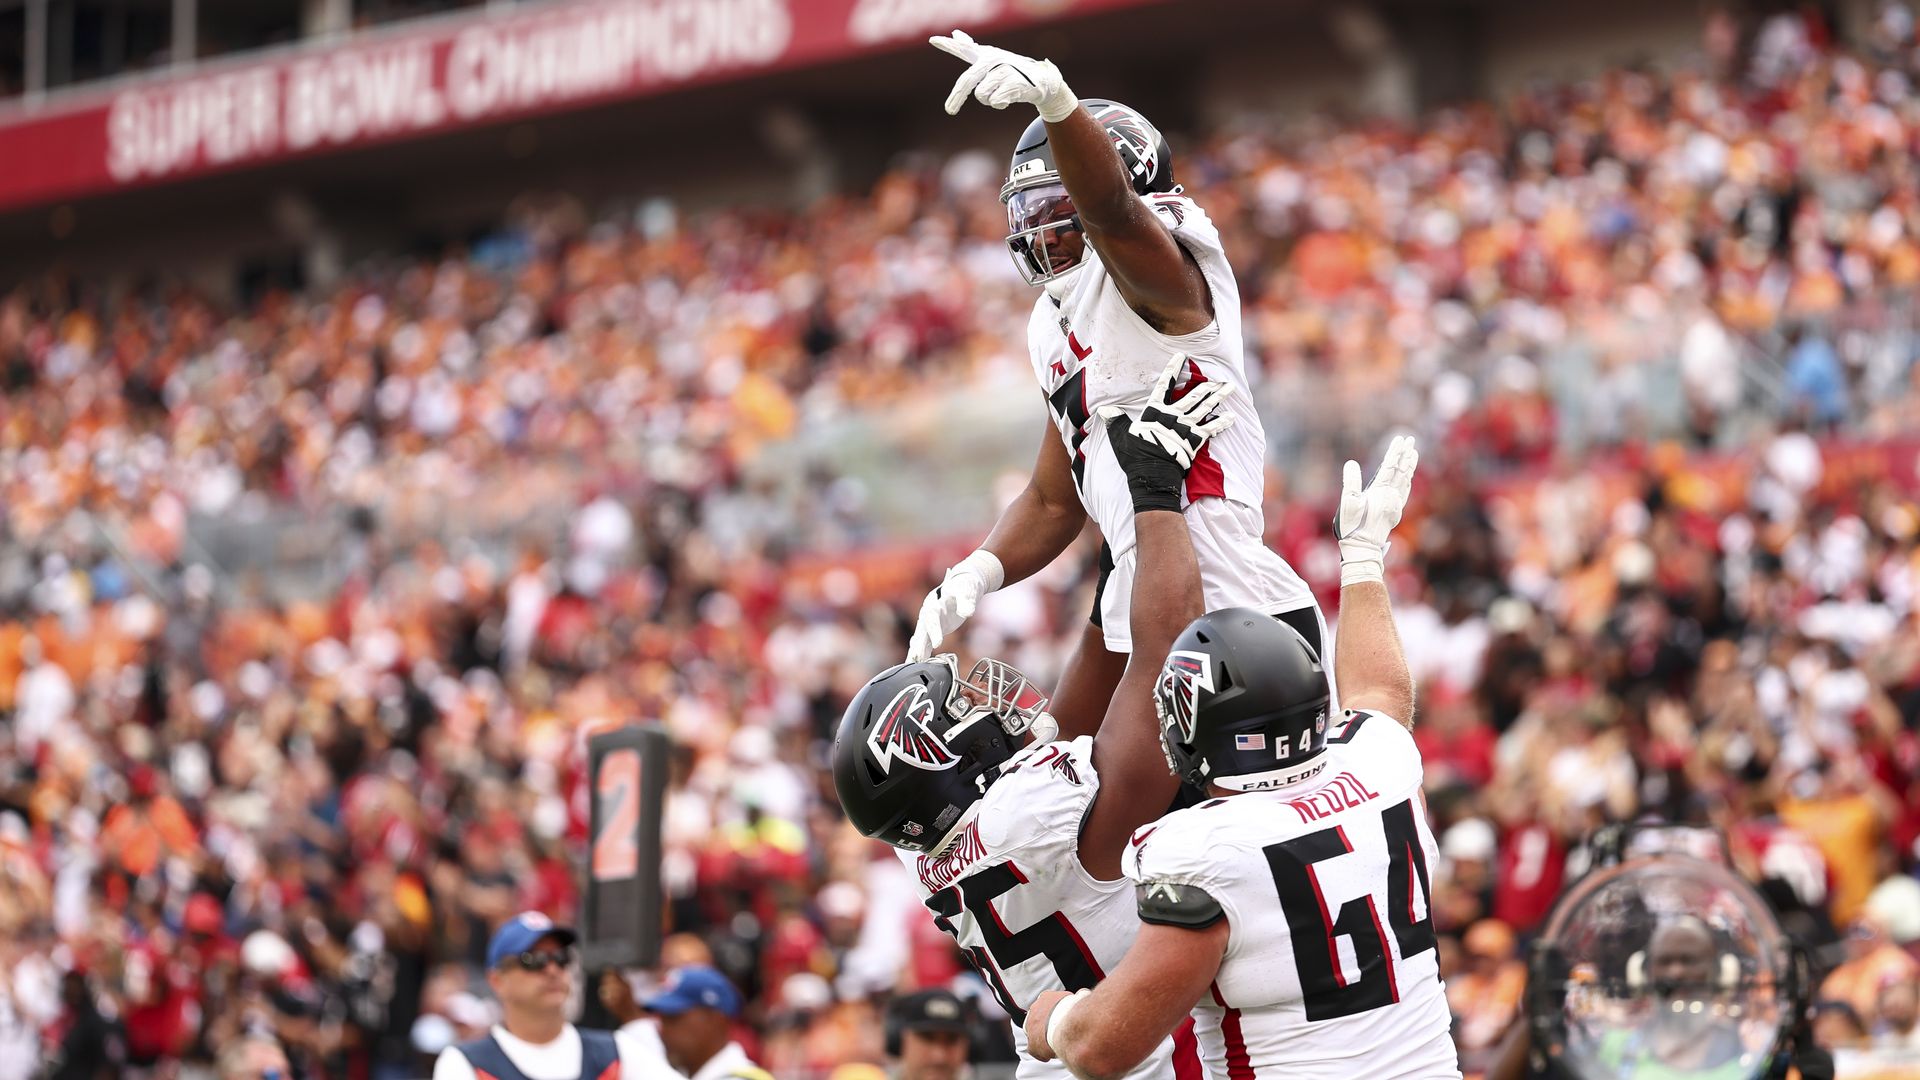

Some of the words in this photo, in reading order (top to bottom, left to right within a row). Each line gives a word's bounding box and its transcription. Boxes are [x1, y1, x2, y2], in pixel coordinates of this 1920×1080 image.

[1013, 163, 1031, 177] ATL
[1275, 728, 1311, 760] 64
[1242, 761, 1328, 790] FALCONS
[592, 749, 641, 881] 2
[1262, 798, 1442, 1022] 64
